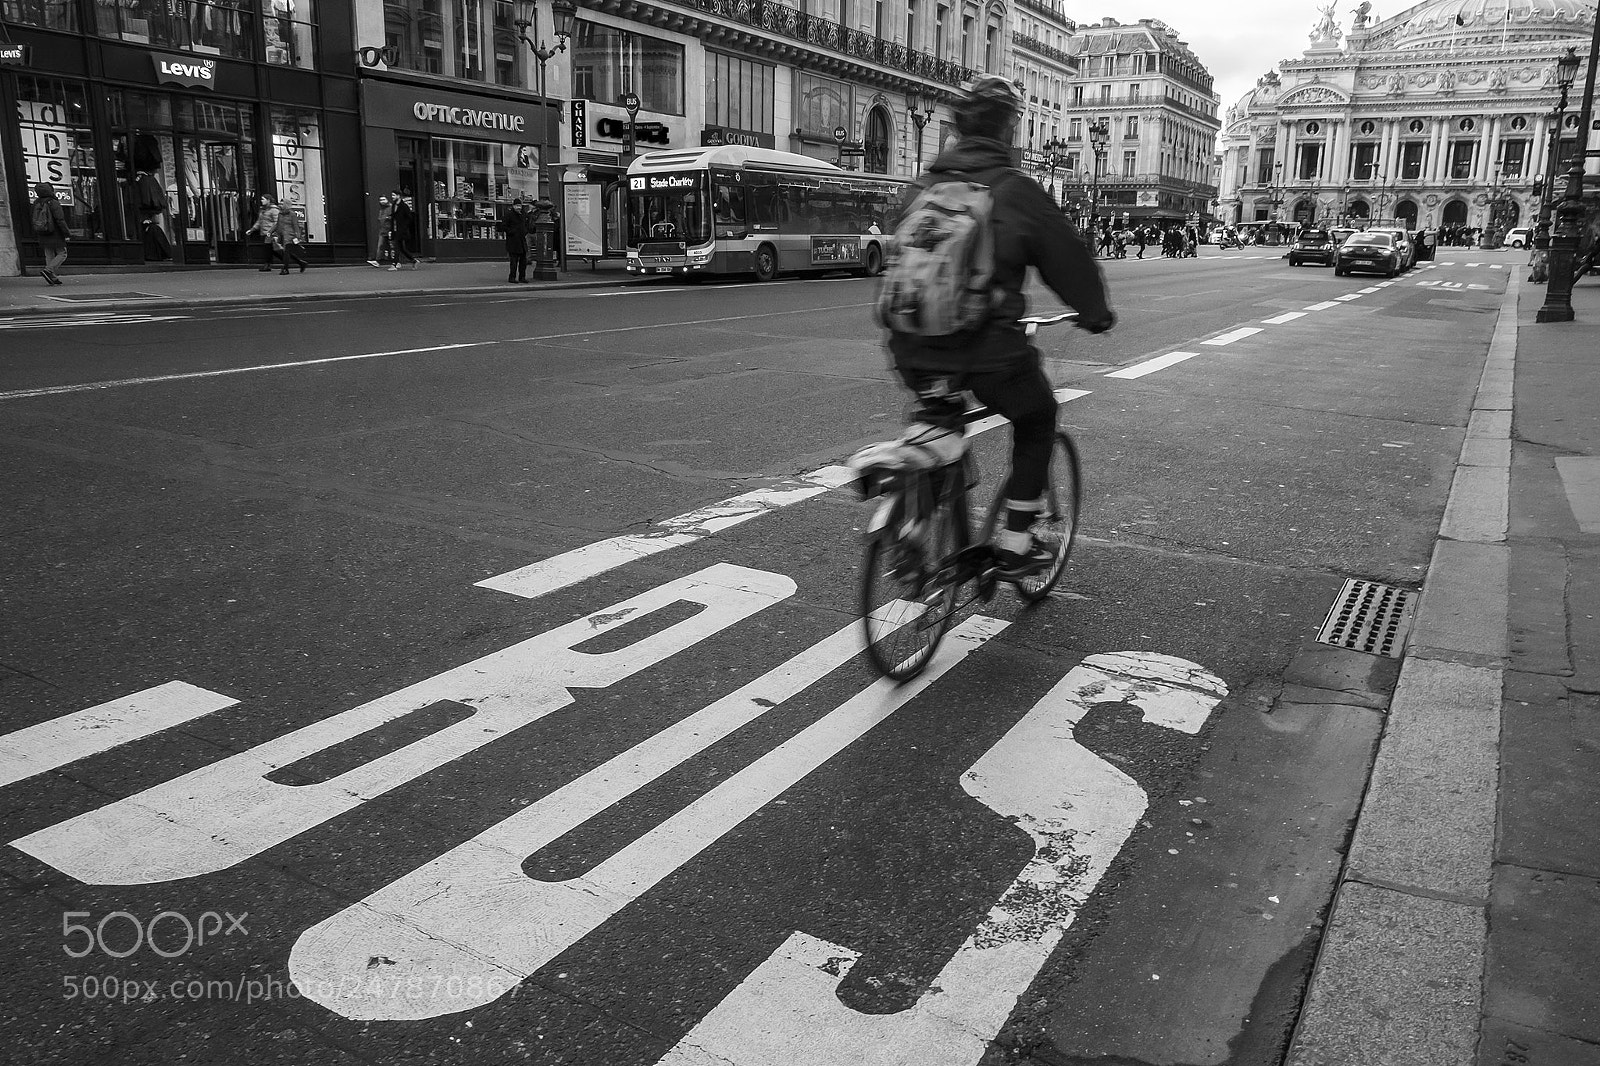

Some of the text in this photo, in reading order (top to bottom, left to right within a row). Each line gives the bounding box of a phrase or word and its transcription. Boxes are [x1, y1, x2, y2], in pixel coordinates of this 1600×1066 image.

[626, 97, 638, 105] BUS
[574, 102, 583, 146] CHANGE
[726, 132, 760, 148] GODIVA
[633, 178, 644, 190] 21
[650, 177, 669, 189] Stade
